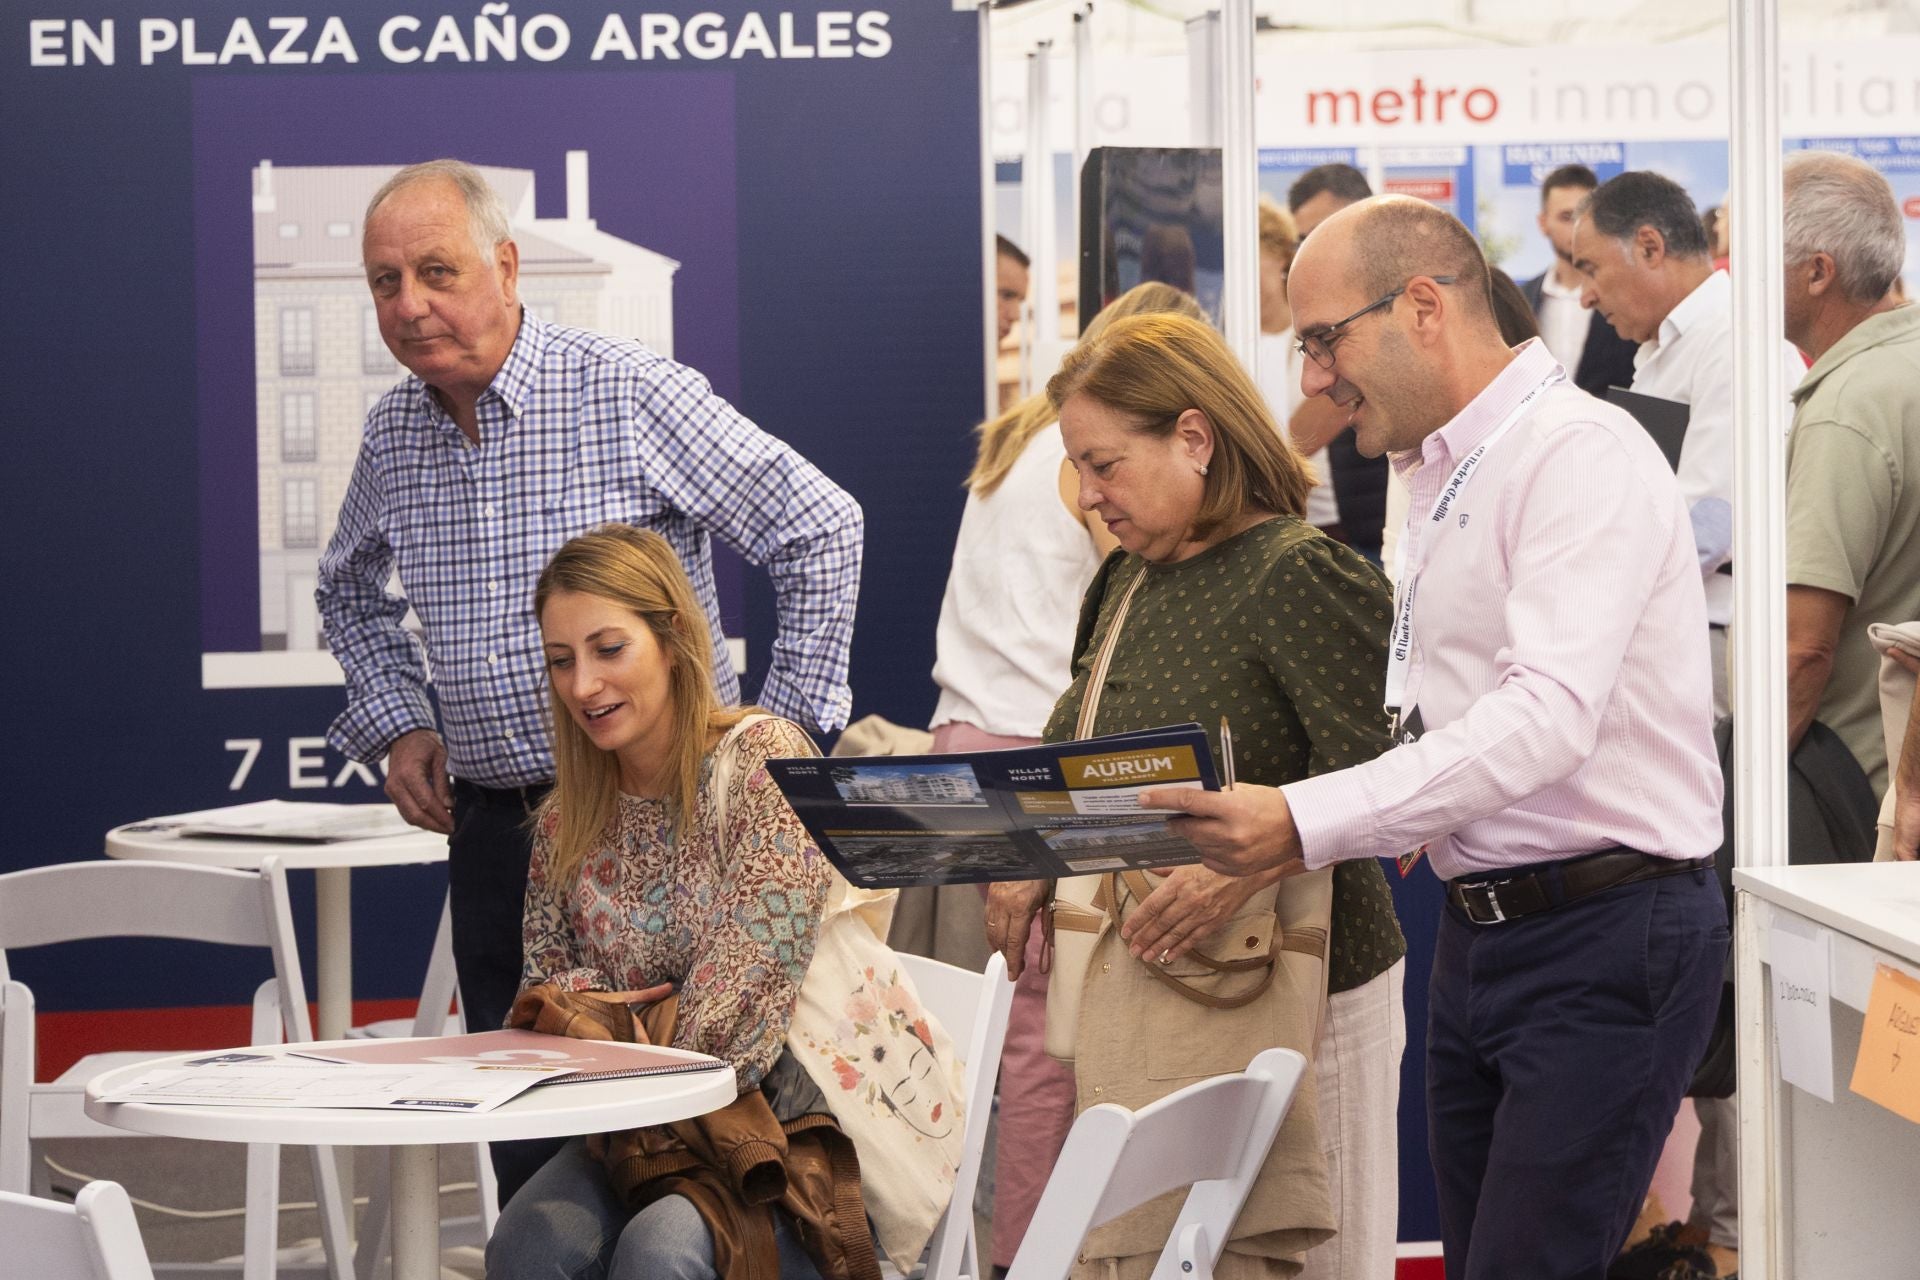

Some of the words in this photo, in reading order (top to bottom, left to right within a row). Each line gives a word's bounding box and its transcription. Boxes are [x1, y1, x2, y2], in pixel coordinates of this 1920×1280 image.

[29, 18, 115, 67] EN
[139, 16, 359, 66] PLAZA
[378, 1, 571, 64] CAÑO
[590, 10, 893, 61] ARGALES
[1307, 77, 1499, 125] metro
[1457, 456, 1477, 479] Norte
[1451, 478, 1463, 488] de
[1432, 488, 1456, 522] Castilla
[1403, 612, 1409, 622] de
[1398, 623, 1409, 647] Norte
[1395, 648, 1406, 661] El
[225, 739, 262, 790] 7
[288, 736, 391, 788] EX
[1008, 767, 1050, 775] VILLAS
[1082, 756, 1174, 779] AURUM
[1011, 774, 1052, 782] NORTE
